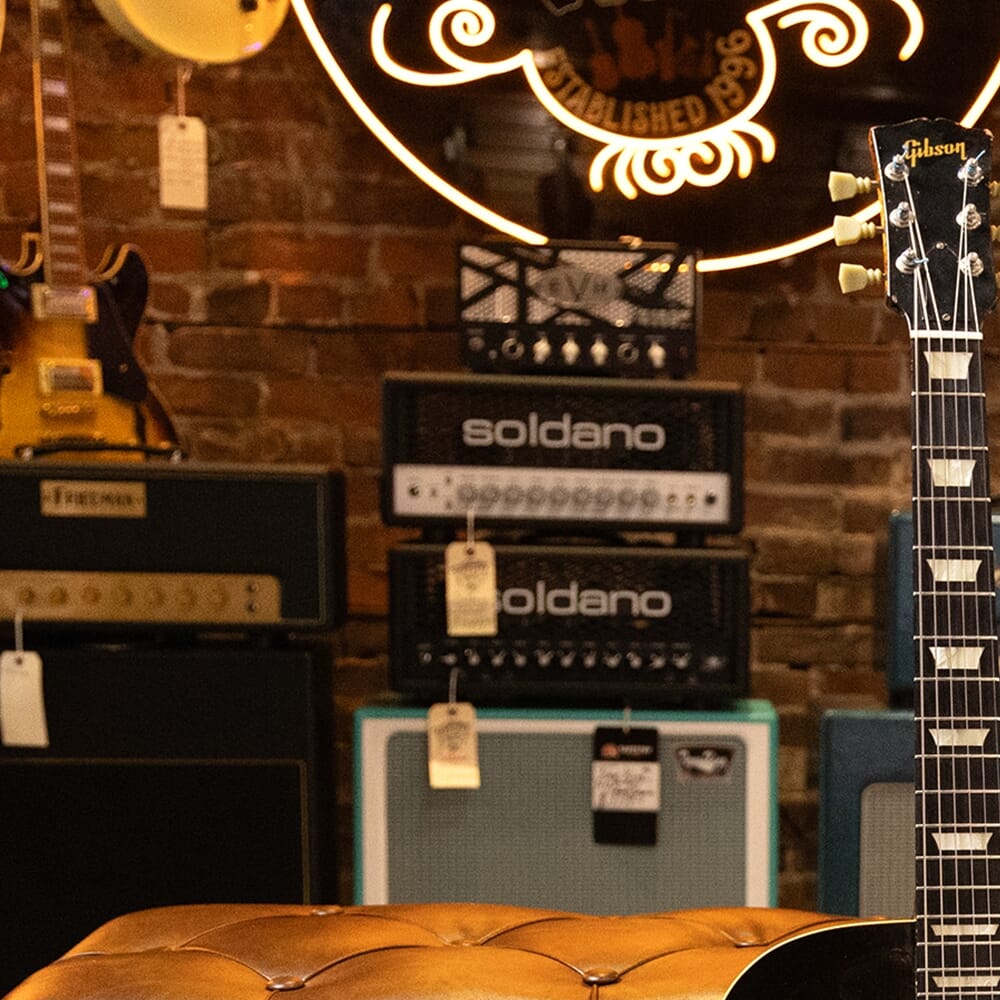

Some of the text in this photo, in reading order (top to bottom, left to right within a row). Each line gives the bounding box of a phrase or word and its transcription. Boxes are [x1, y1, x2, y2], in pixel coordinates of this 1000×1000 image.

[704, 28, 758, 118] 1996
[903, 137, 967, 168] Gibson
[462, 411, 666, 452] soldano
